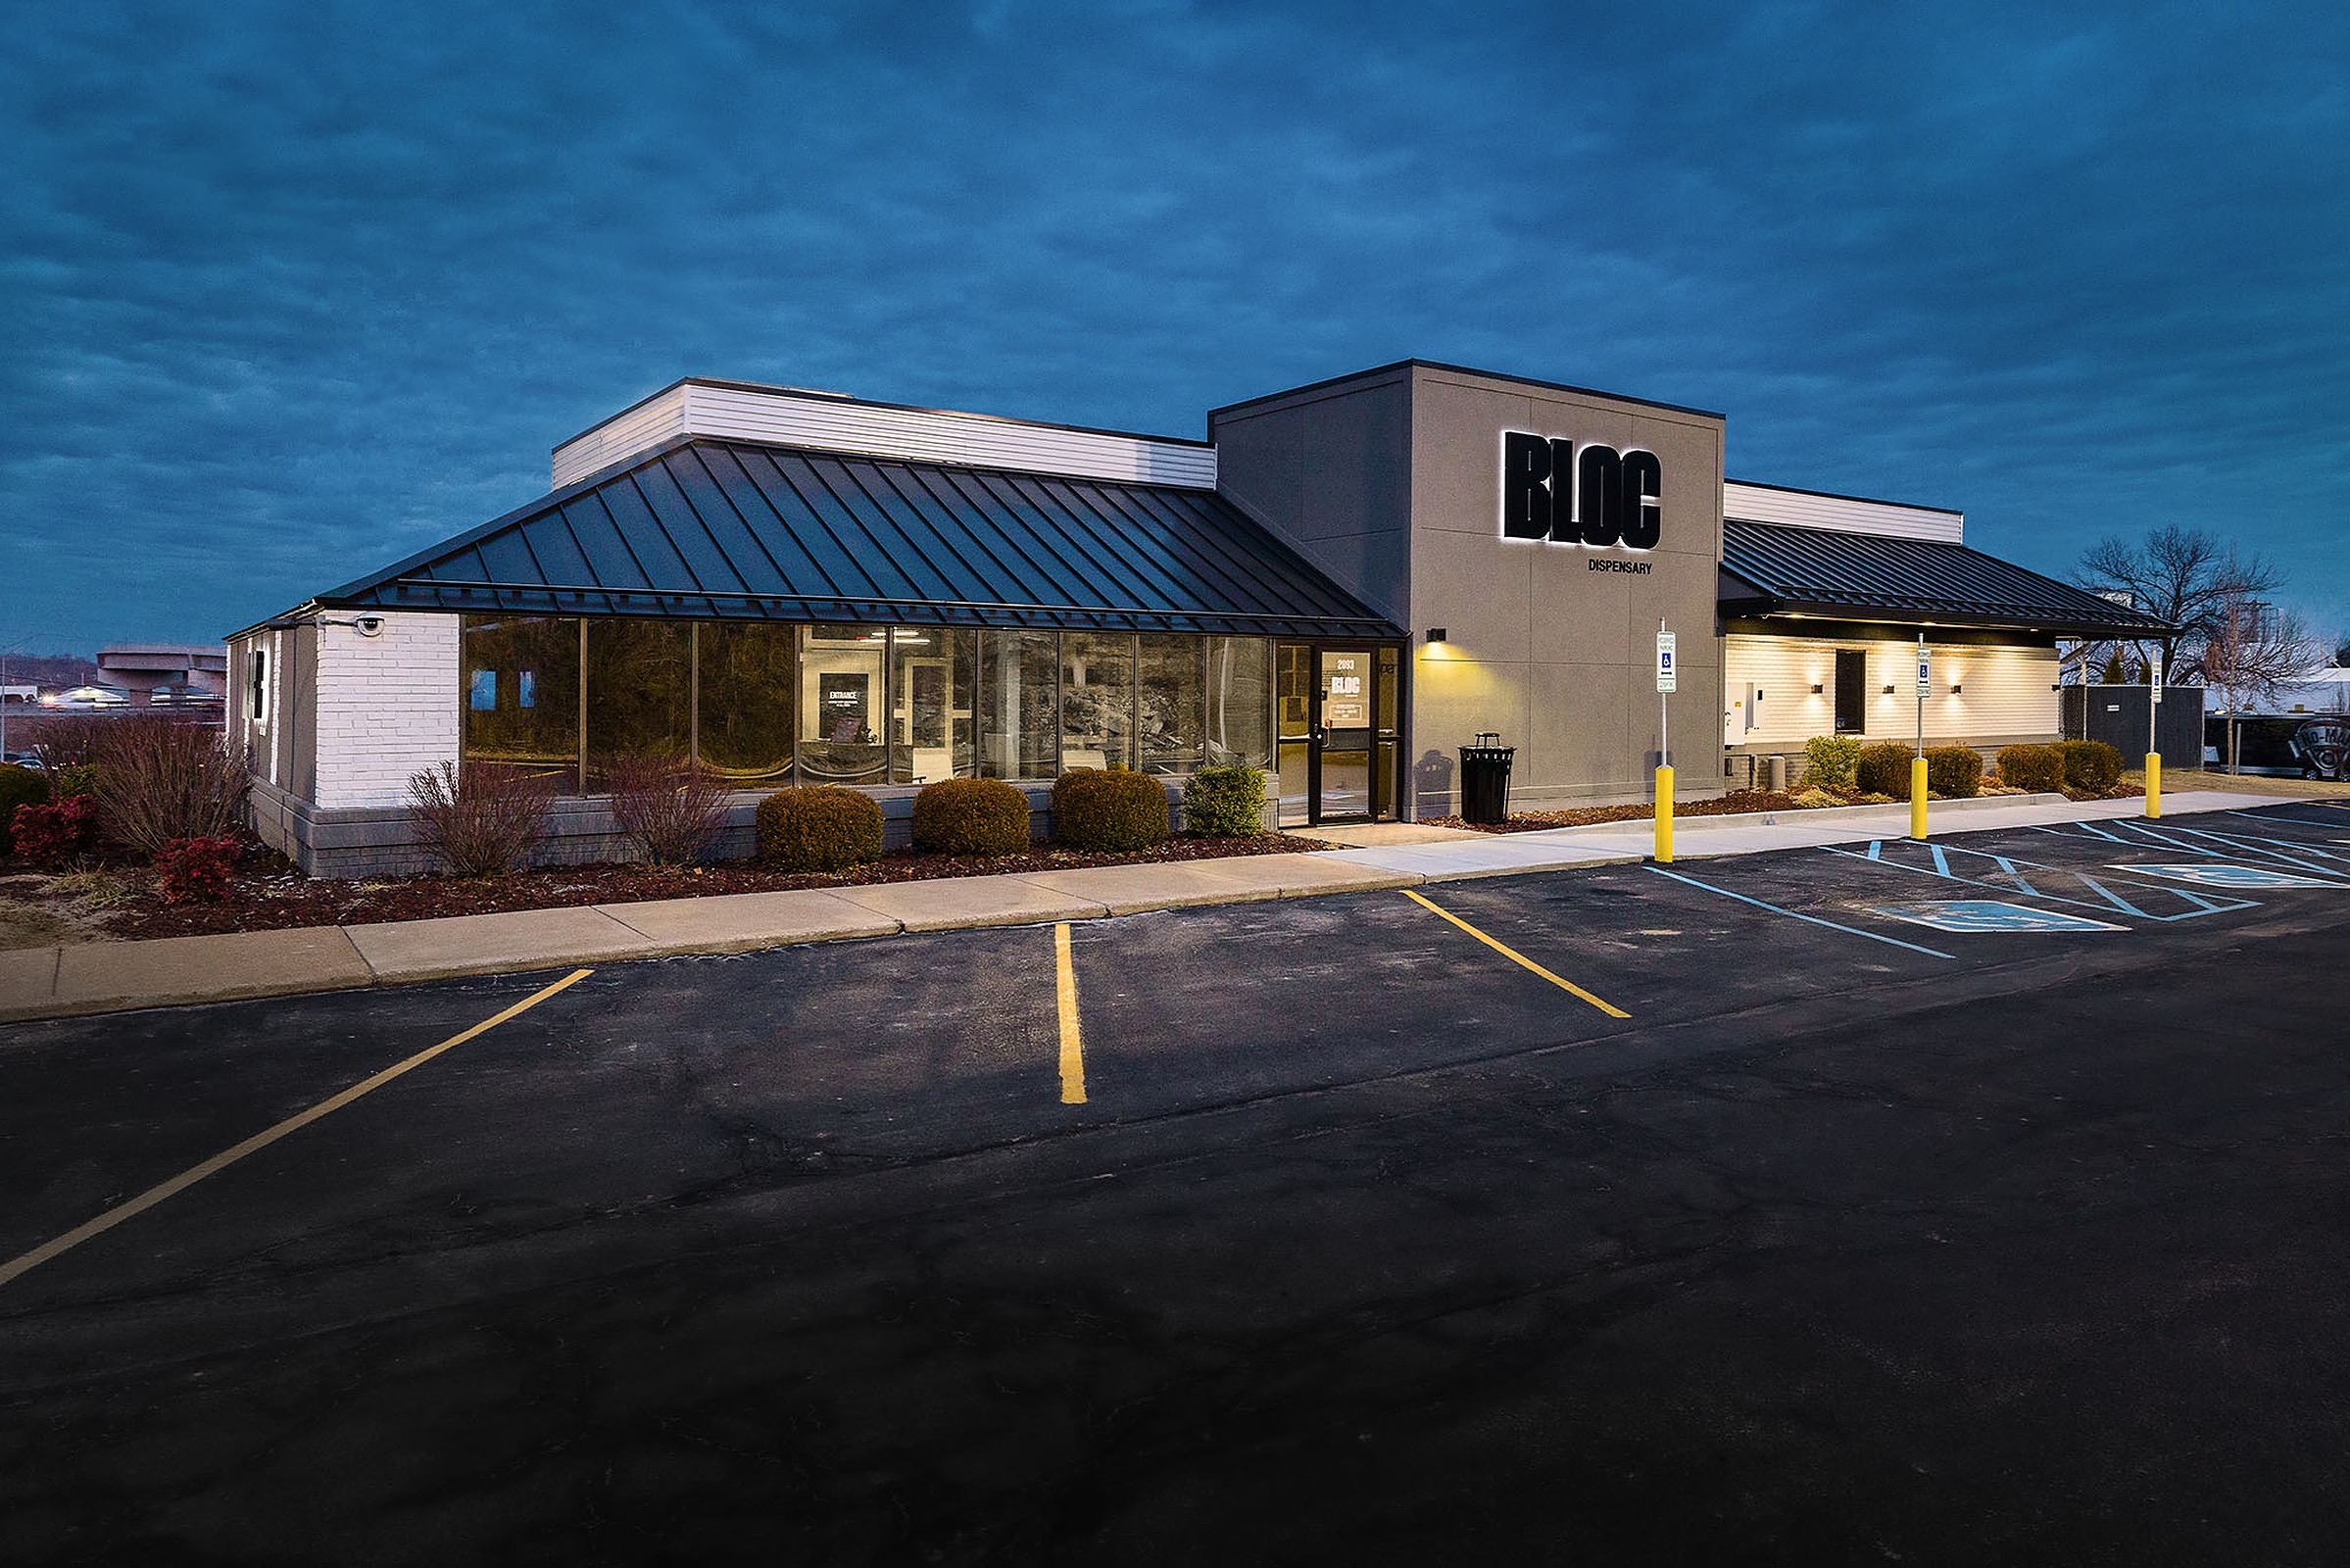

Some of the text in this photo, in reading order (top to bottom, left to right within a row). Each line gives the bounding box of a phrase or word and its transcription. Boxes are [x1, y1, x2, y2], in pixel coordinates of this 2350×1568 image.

[1504, 431, 1661, 550] BLOC
[1589, 559, 1652, 574] DISPENSARY
[1331, 676, 1360, 694] BLOC
